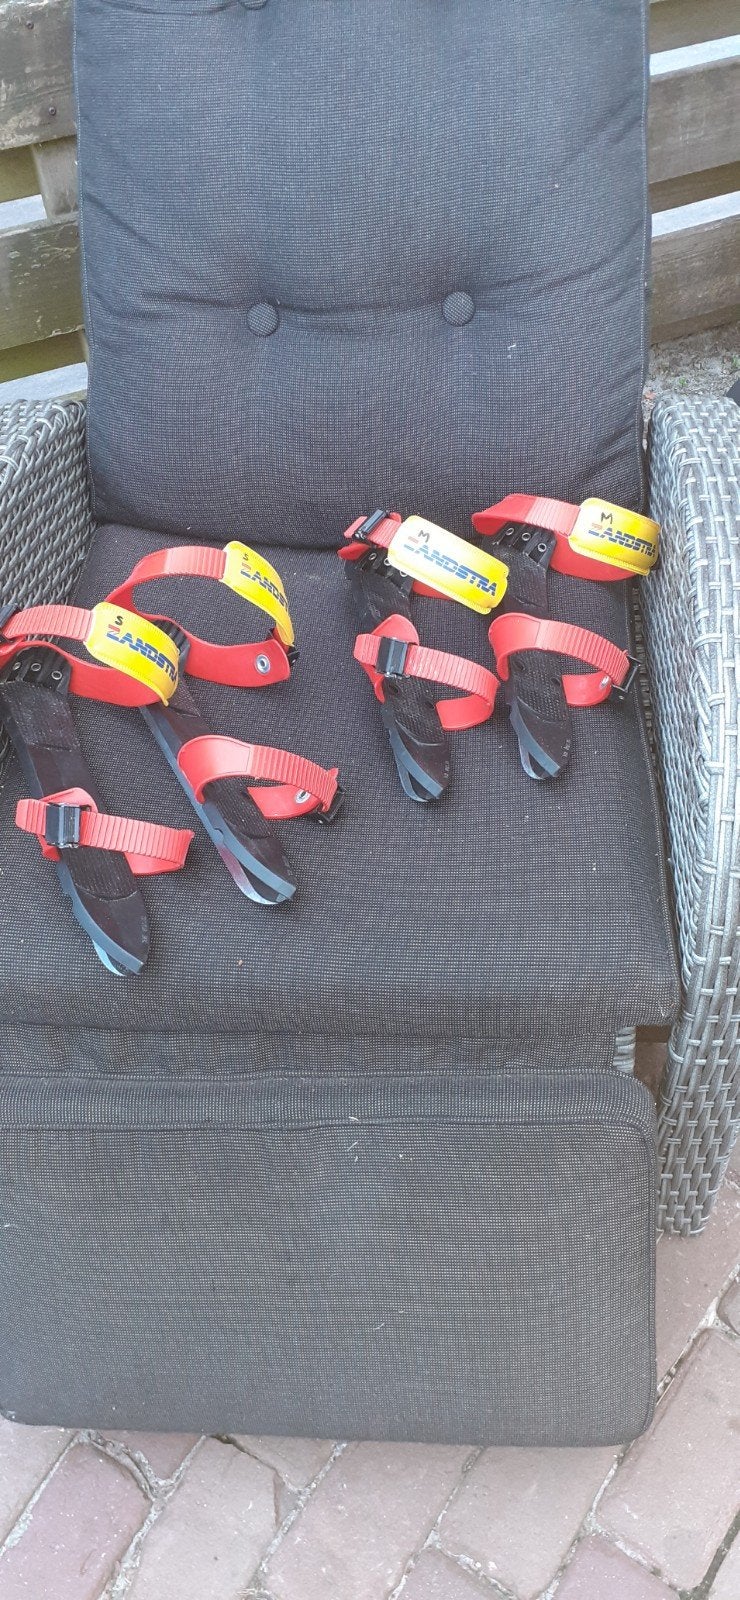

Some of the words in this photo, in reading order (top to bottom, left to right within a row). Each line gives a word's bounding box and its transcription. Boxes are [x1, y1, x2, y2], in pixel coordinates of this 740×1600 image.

[600, 512, 613, 525] M
[418, 529, 430, 543] M
[242, 553, 249, 561] S
[403, 536, 497, 597] ZANDSTRA
[114, 615, 124, 626] S
